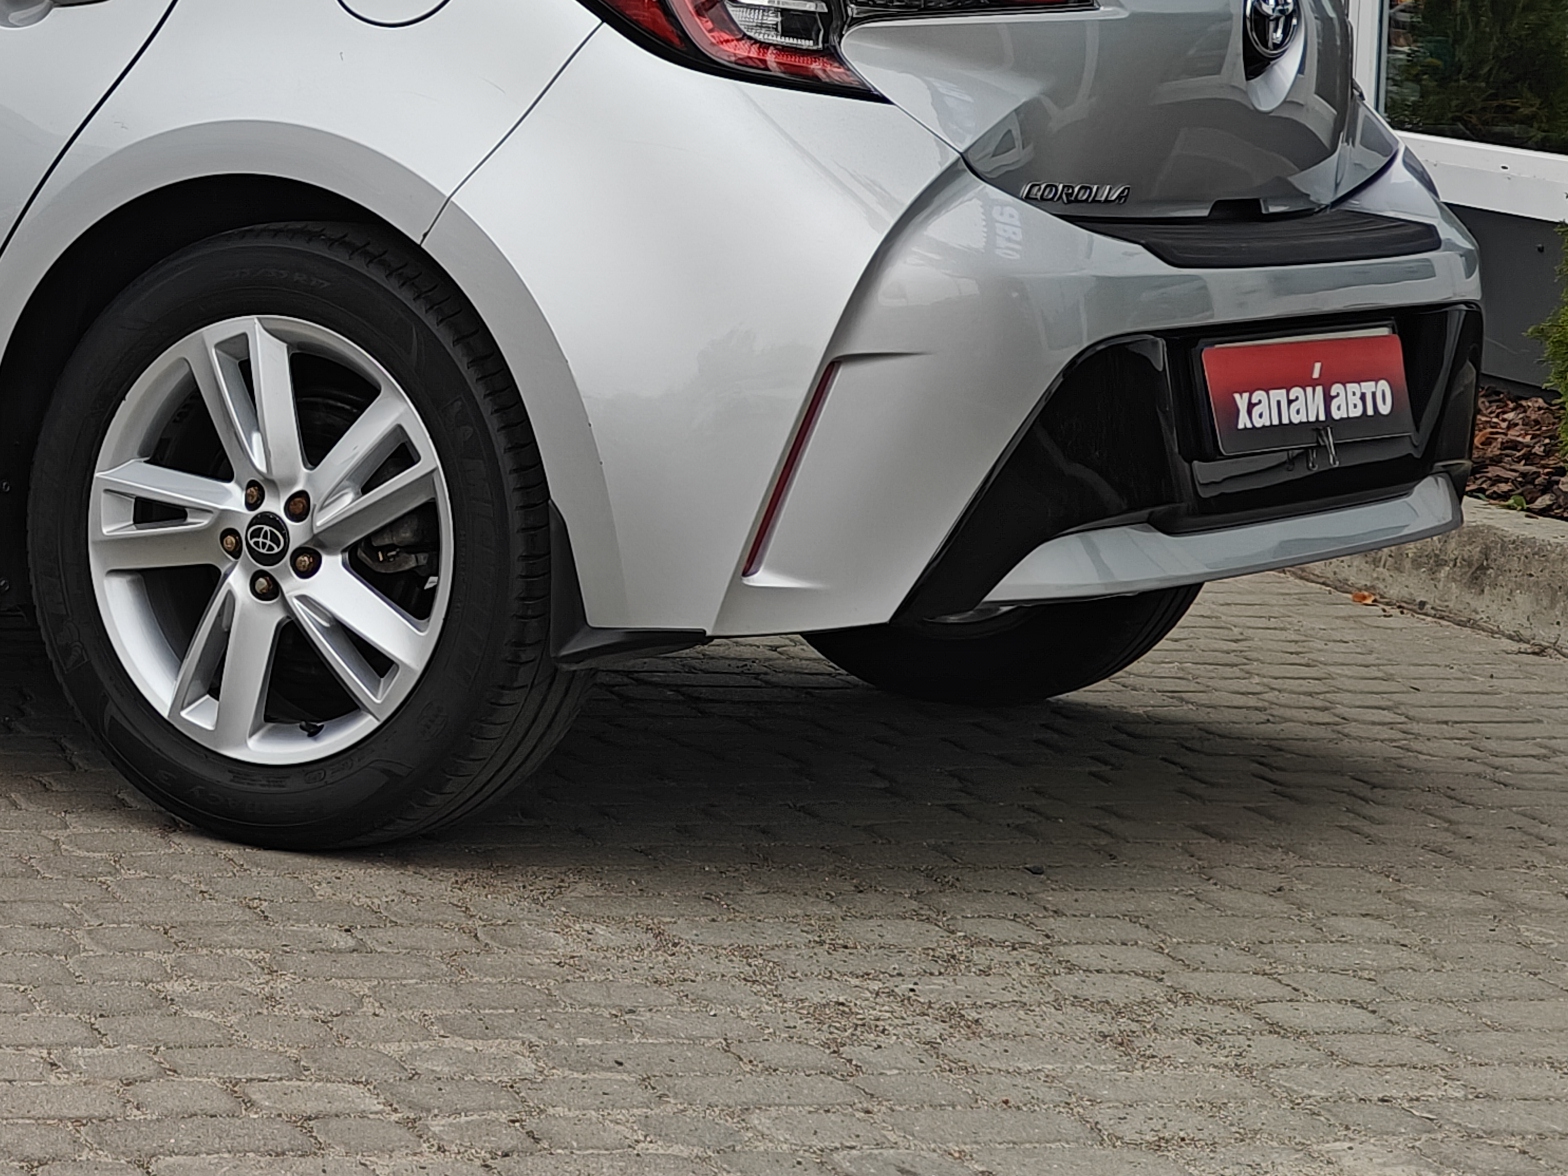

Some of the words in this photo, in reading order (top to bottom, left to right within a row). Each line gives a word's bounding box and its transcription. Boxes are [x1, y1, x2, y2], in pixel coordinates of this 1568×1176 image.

[1020, 181, 1131, 204] COROLLA
[1233, 362, 1326, 430] хапай
[1330, 379, 1393, 421] авто
